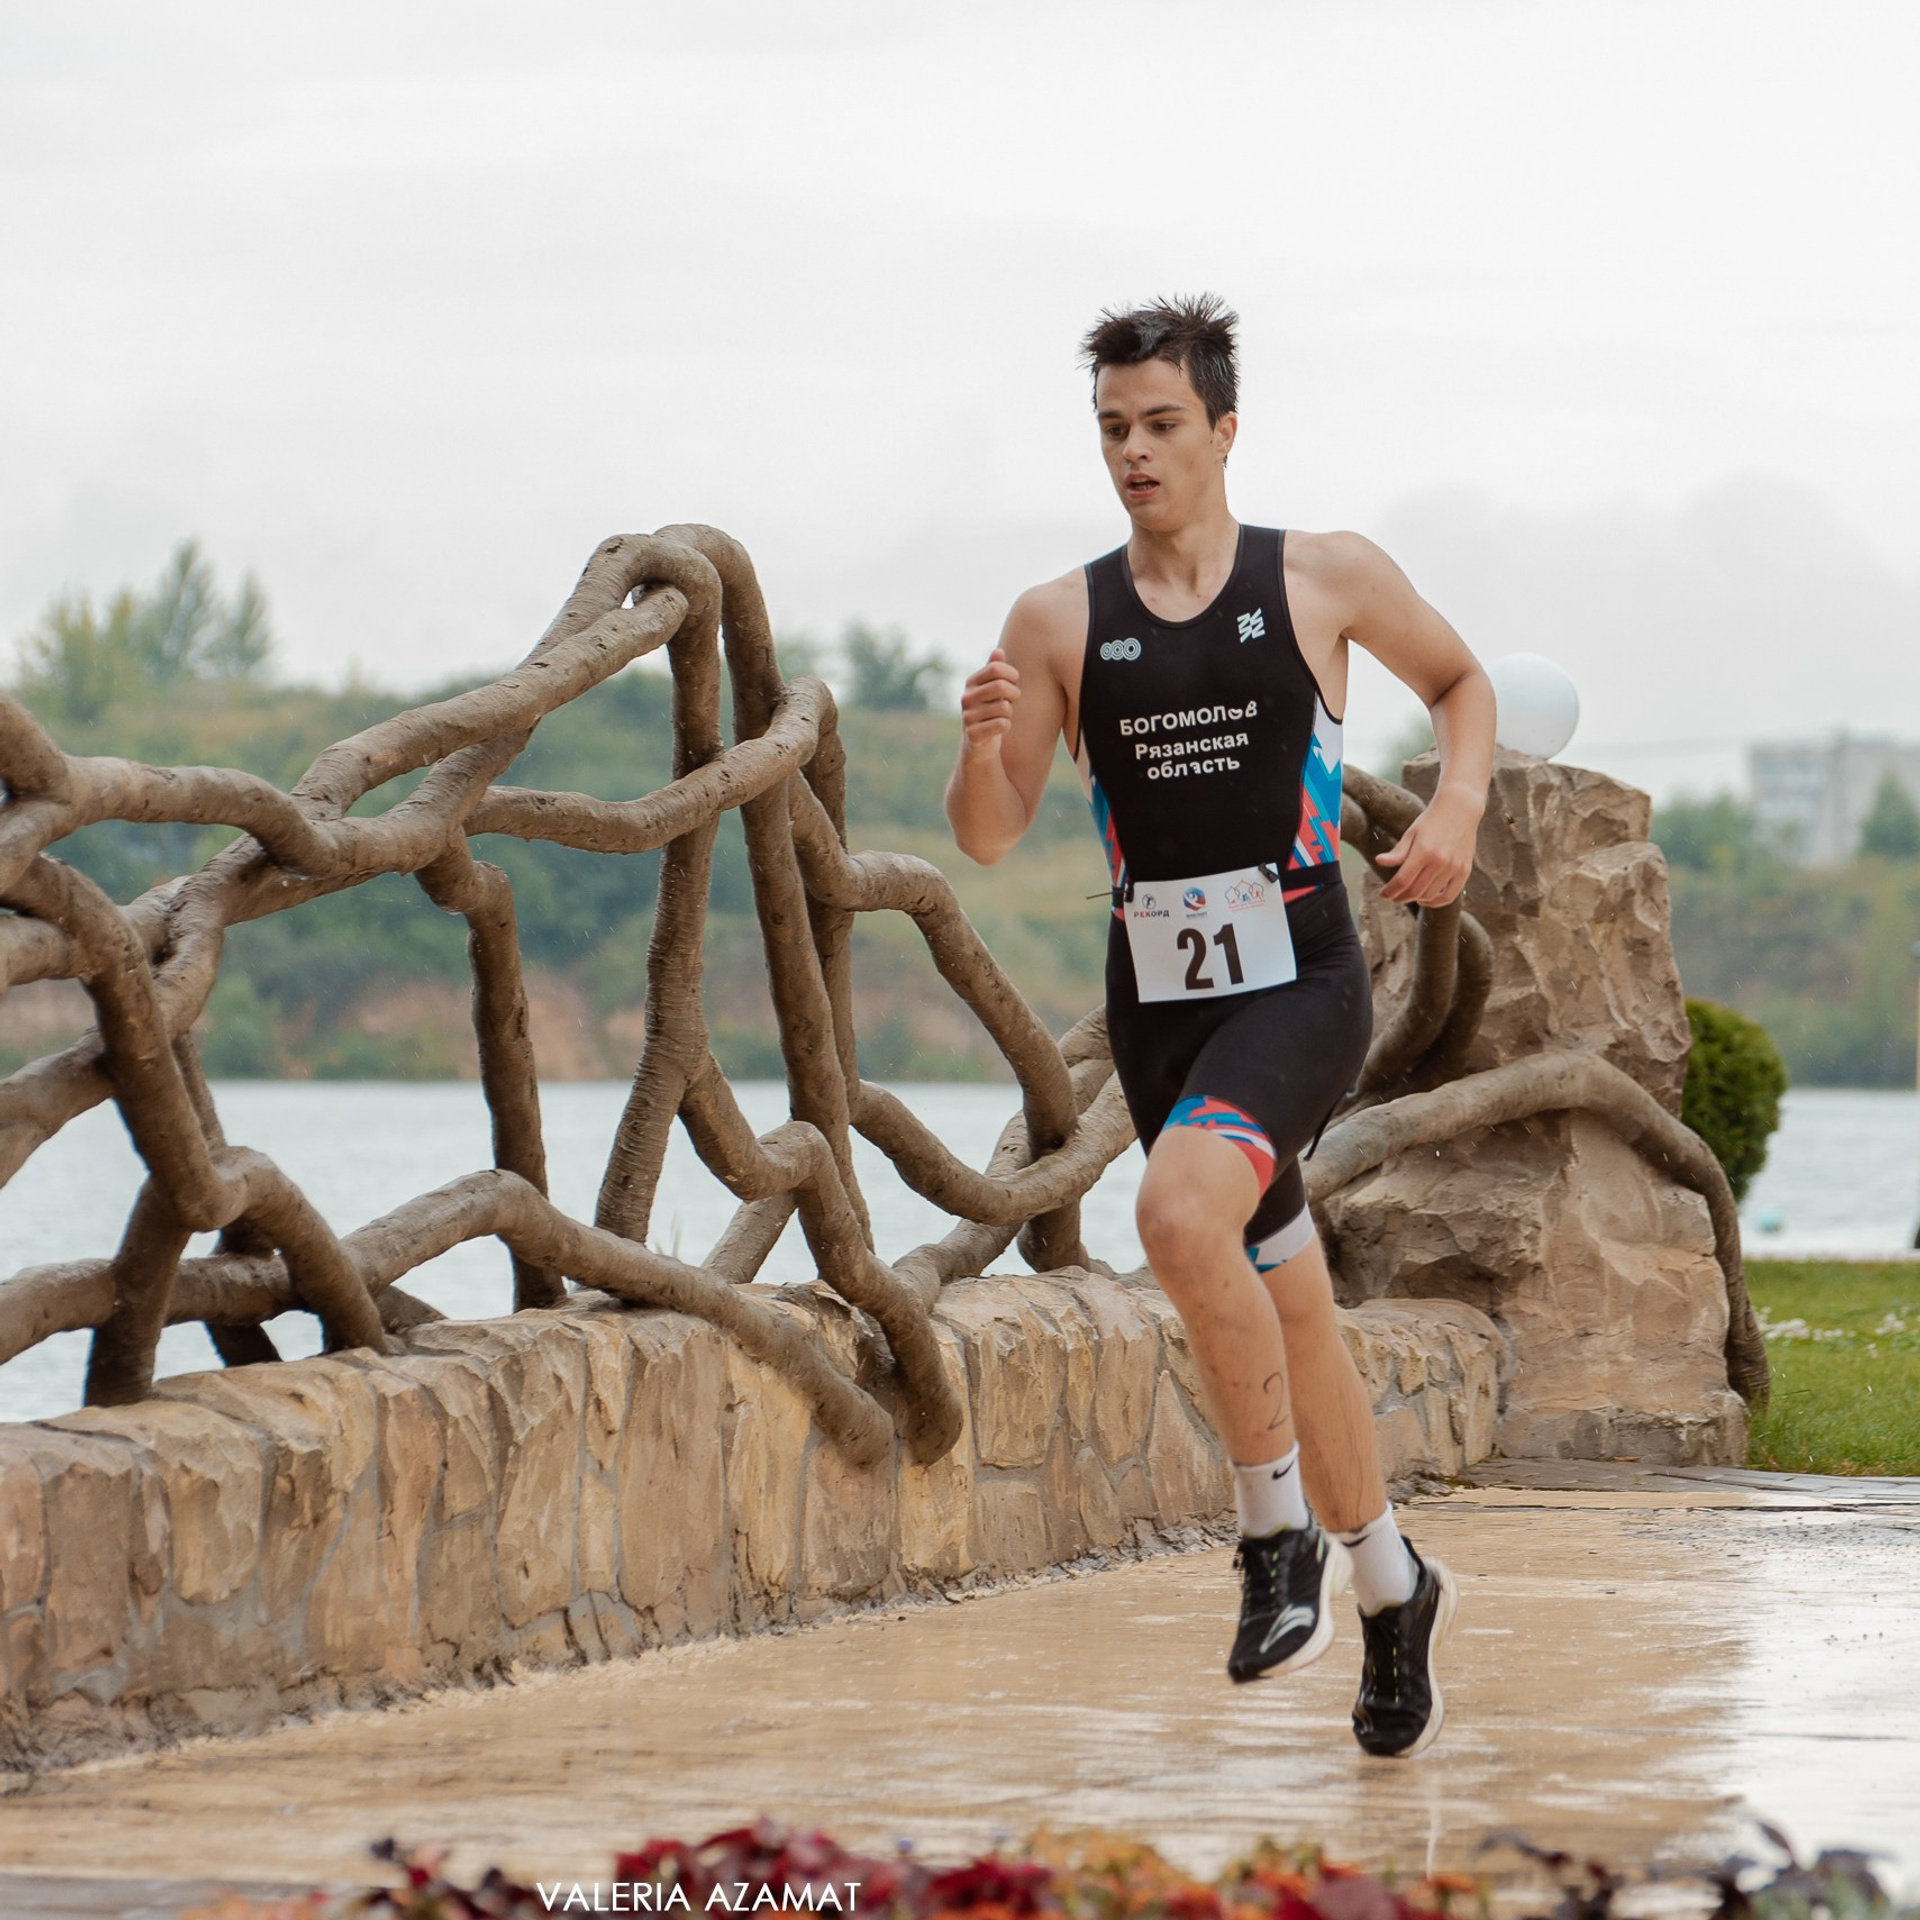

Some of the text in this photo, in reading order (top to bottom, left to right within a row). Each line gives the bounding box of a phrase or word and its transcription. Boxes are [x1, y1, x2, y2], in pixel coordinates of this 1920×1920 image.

[1119, 700, 1258, 736] БОГОМОЛОВ
[1134, 732, 1249, 760] Рязанская
[1147, 756, 1240, 780] область
[1133, 909, 1170, 918] РЕКОРД
[1176, 922, 1245, 991] 21
